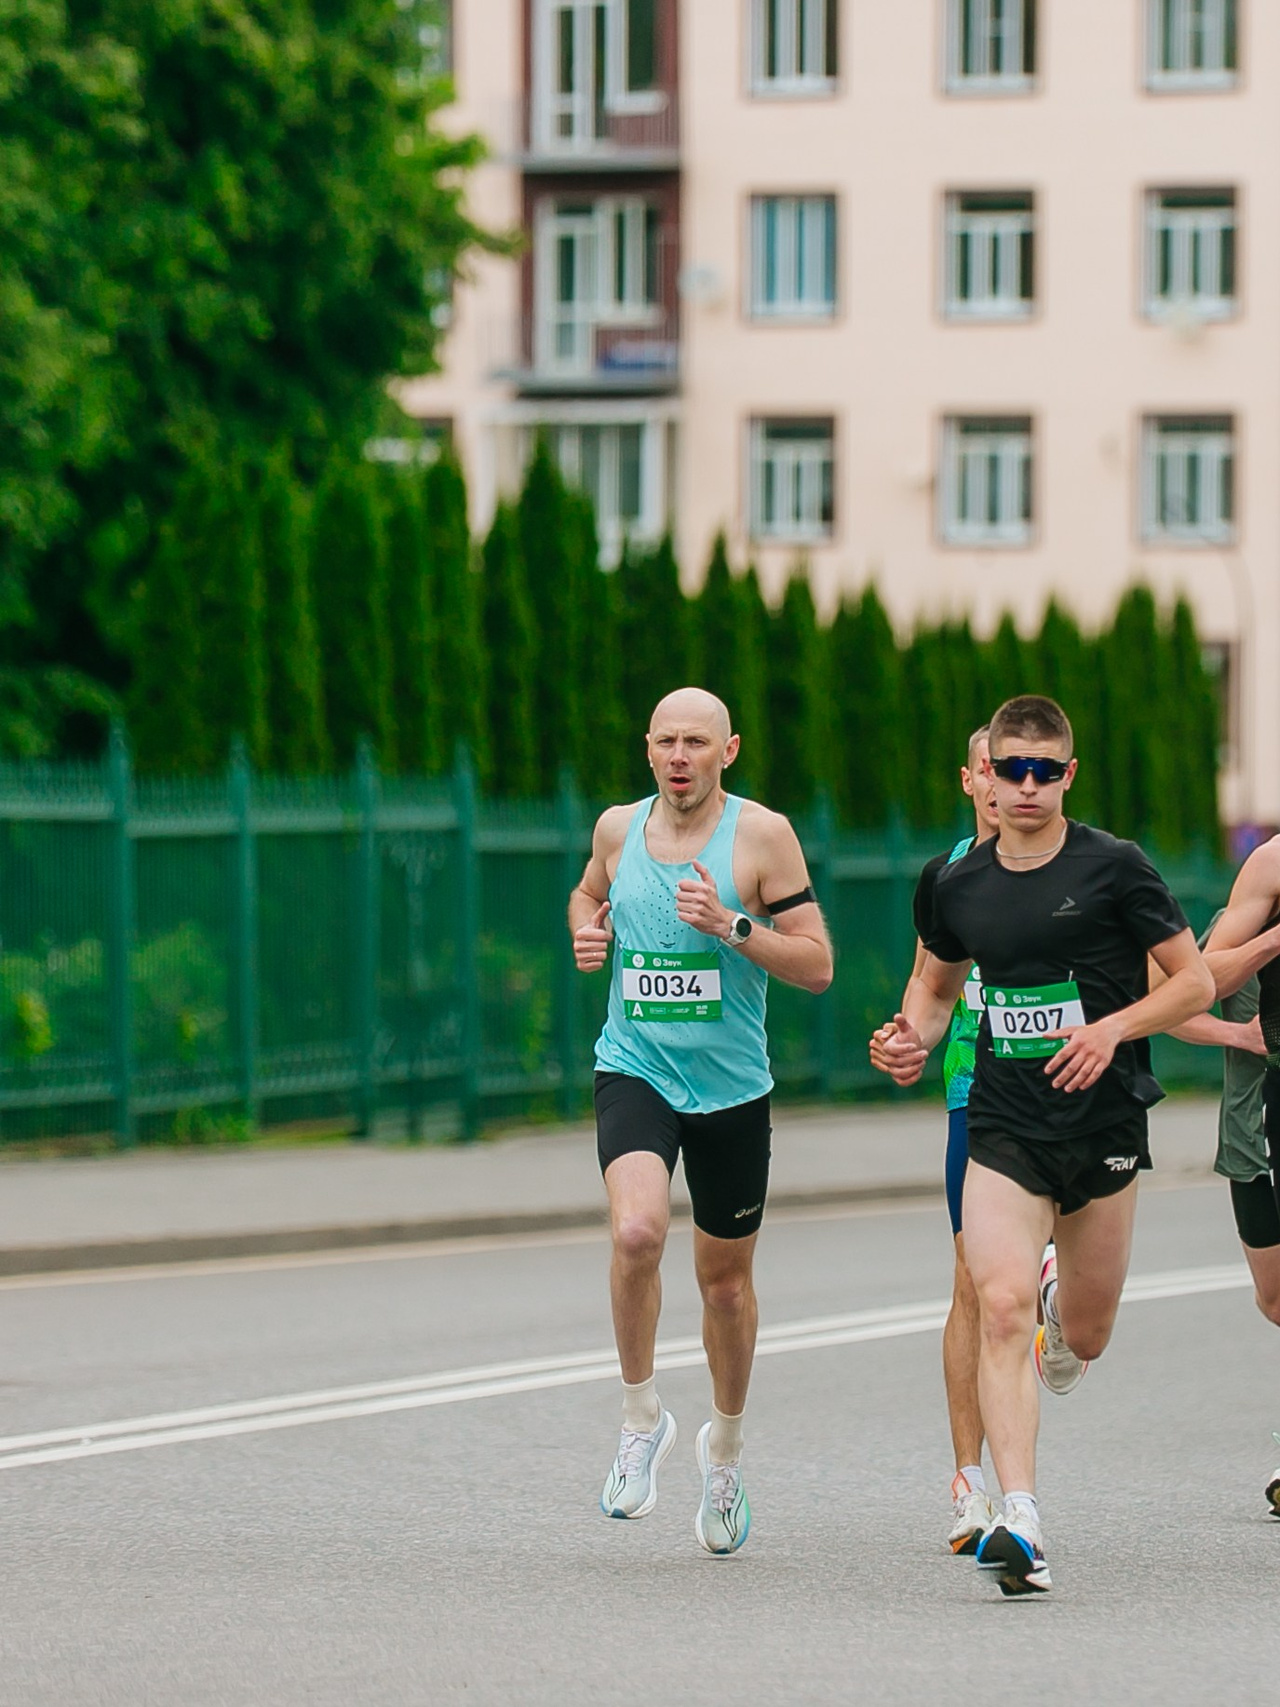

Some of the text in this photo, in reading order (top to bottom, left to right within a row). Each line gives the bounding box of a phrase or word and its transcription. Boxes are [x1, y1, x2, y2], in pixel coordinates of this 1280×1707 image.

[663, 959, 682, 967] Звук
[639, 974, 702, 997] 0034
[1003, 1008, 1063, 1034] 0207
